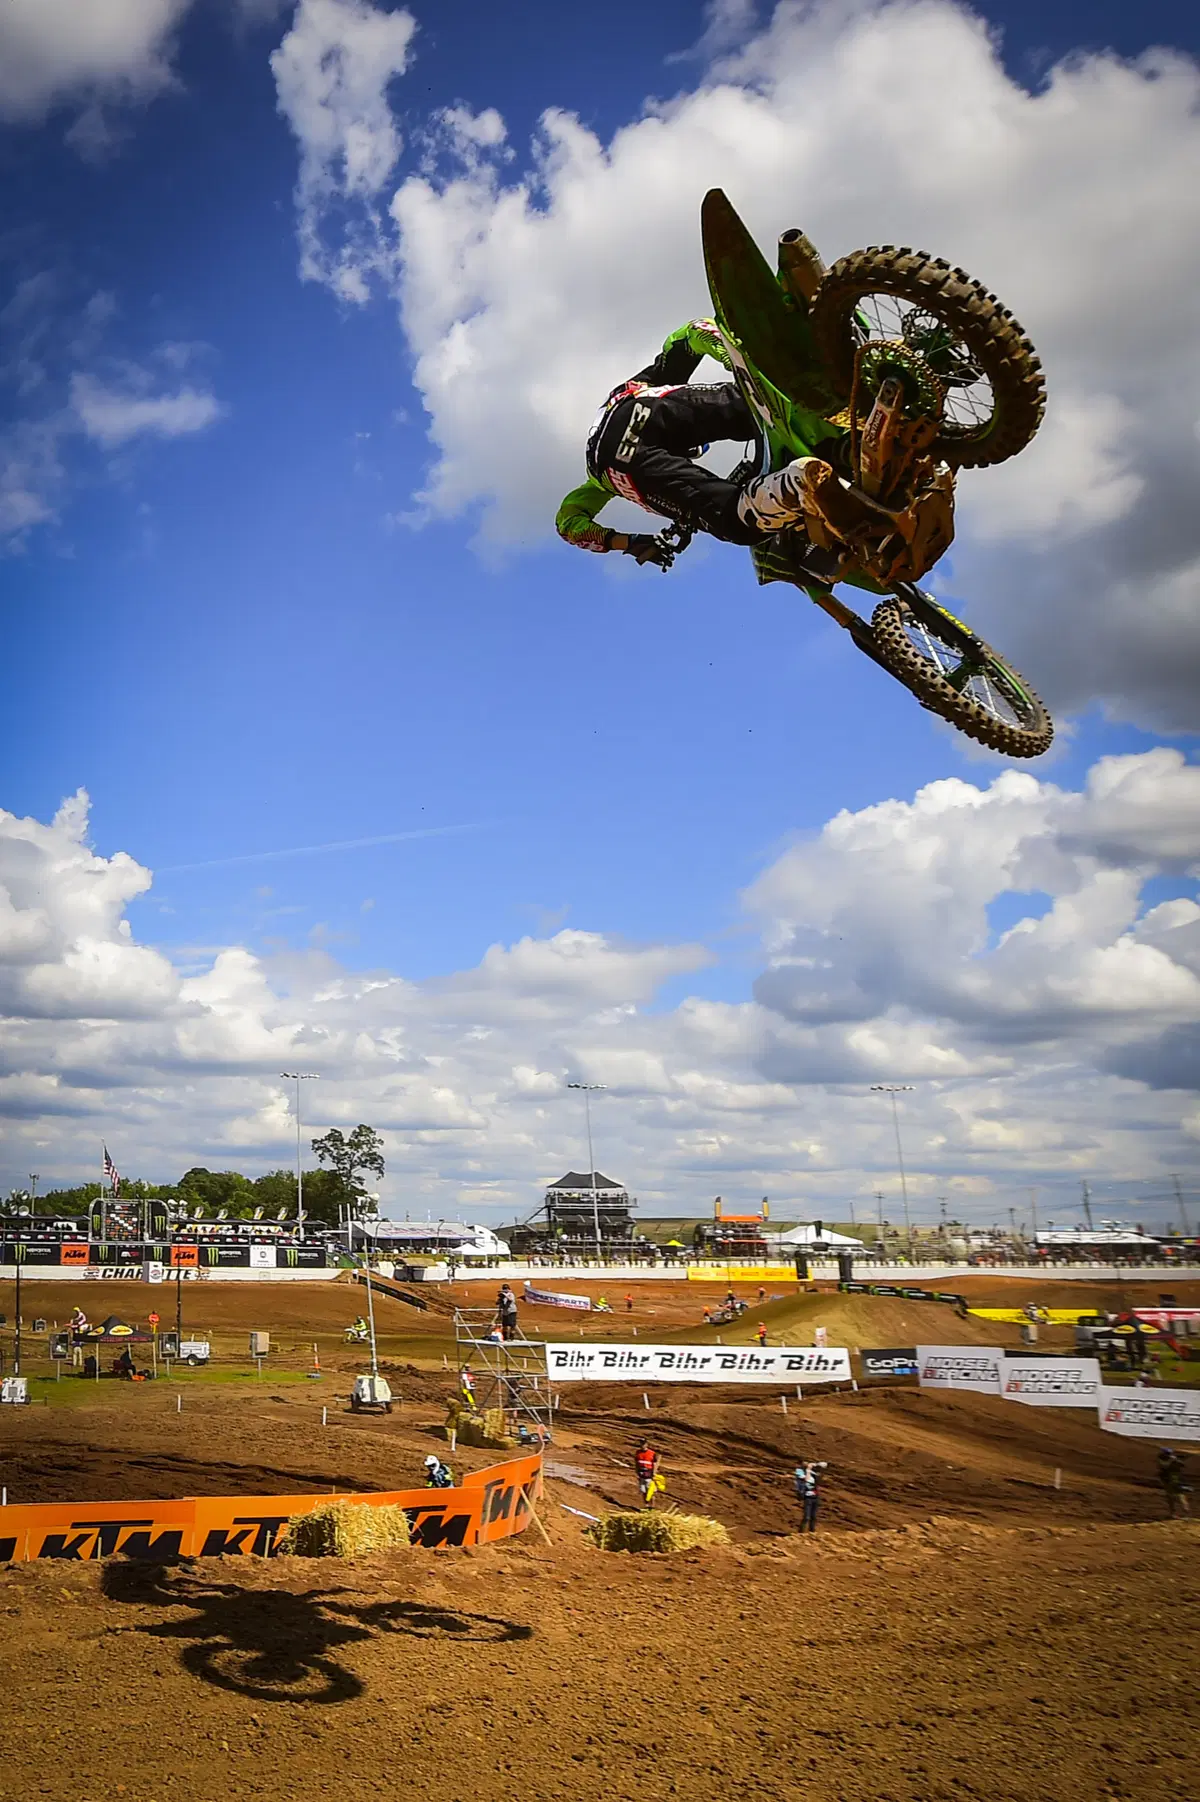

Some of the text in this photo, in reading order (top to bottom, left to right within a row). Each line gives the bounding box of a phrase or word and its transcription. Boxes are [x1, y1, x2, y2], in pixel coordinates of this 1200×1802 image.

[64, 1249, 87, 1259] KTM
[174, 1250, 195, 1260] KTM
[101, 1268, 193, 1280] CHARTTE
[550, 1351, 844, 1371] Bihr Bihr Bihr Bihr Bihr
[925, 1356, 990, 1370] MOOSE
[936, 1367, 999, 1382] RACING
[1009, 1369, 1082, 1382] MOOSE
[1020, 1381, 1098, 1394] RACING
[1107, 1398, 1189, 1413] MOOSE
[402, 1505, 473, 1548] TM
[37, 1519, 184, 1561] KTM
[200, 1516, 290, 1557] KT
